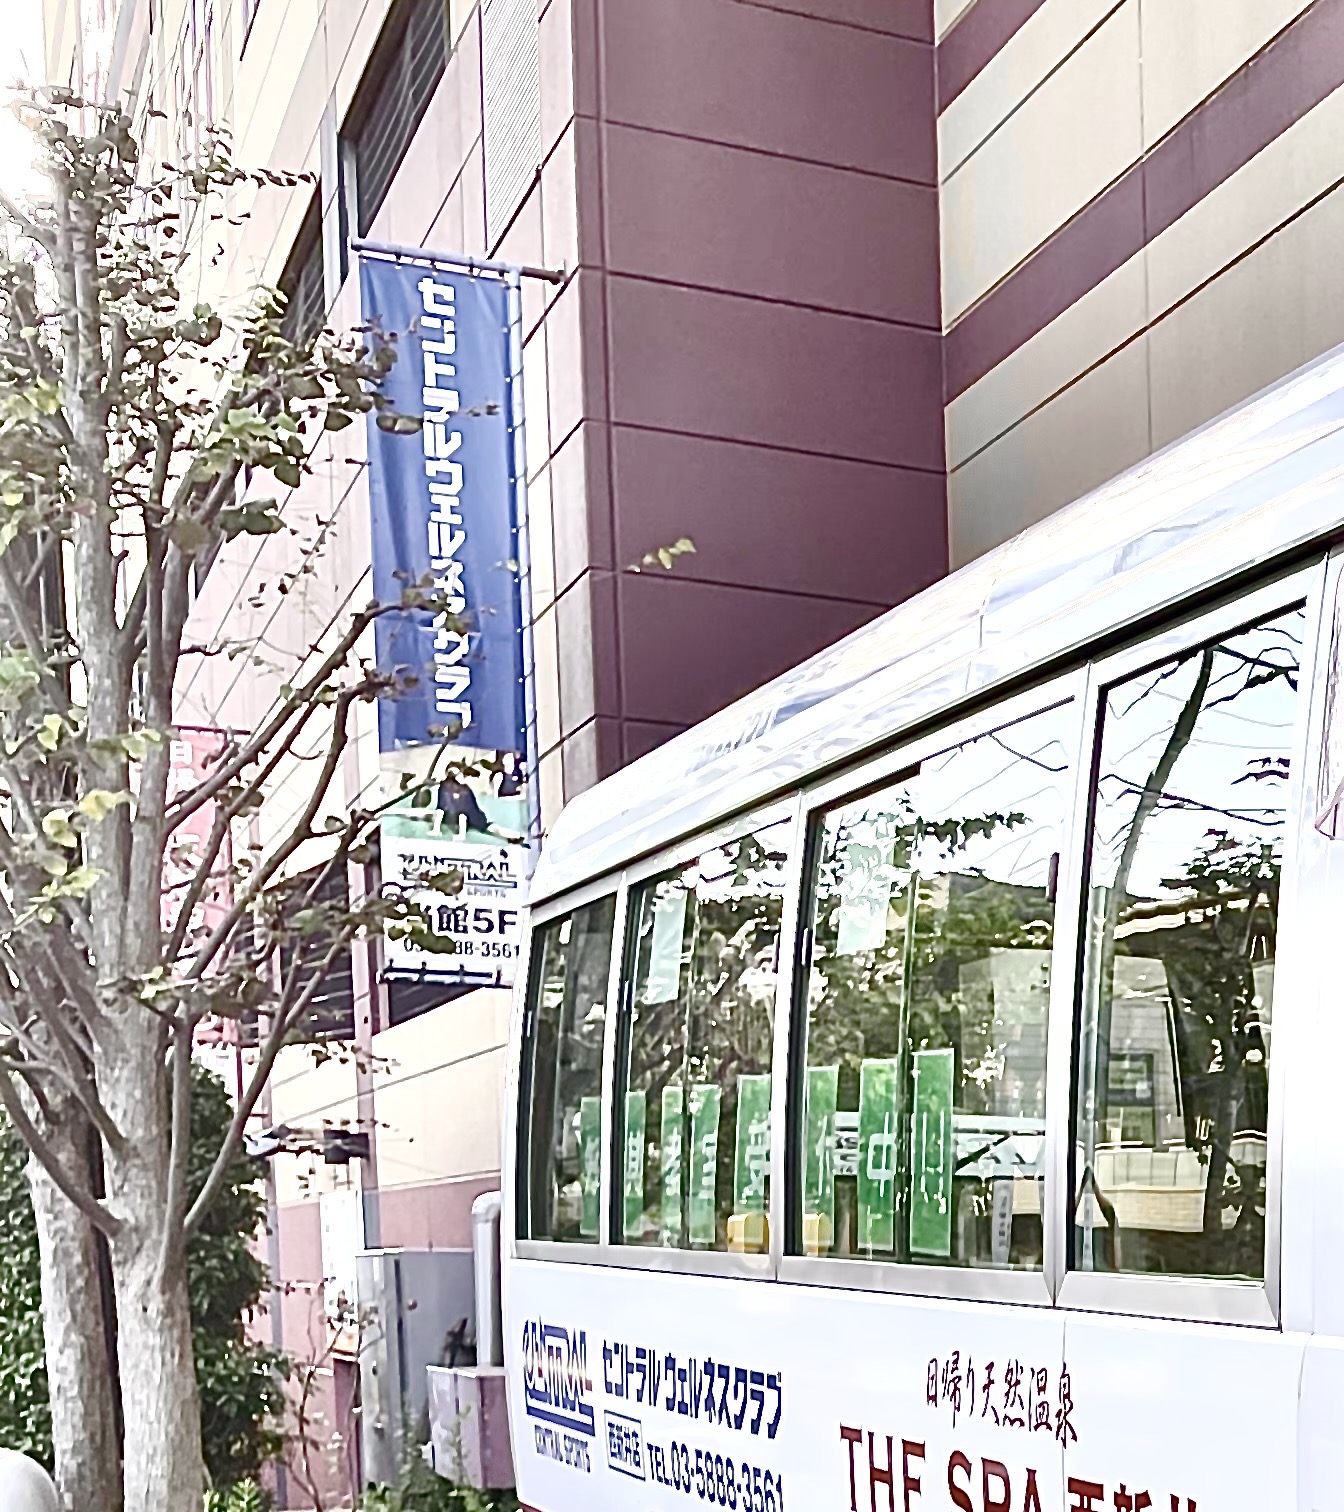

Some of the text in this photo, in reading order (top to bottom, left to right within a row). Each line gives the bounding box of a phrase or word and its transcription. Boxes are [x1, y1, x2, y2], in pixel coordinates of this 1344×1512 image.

[926, 1350, 1078, 1449] 日帰り天然温泉
